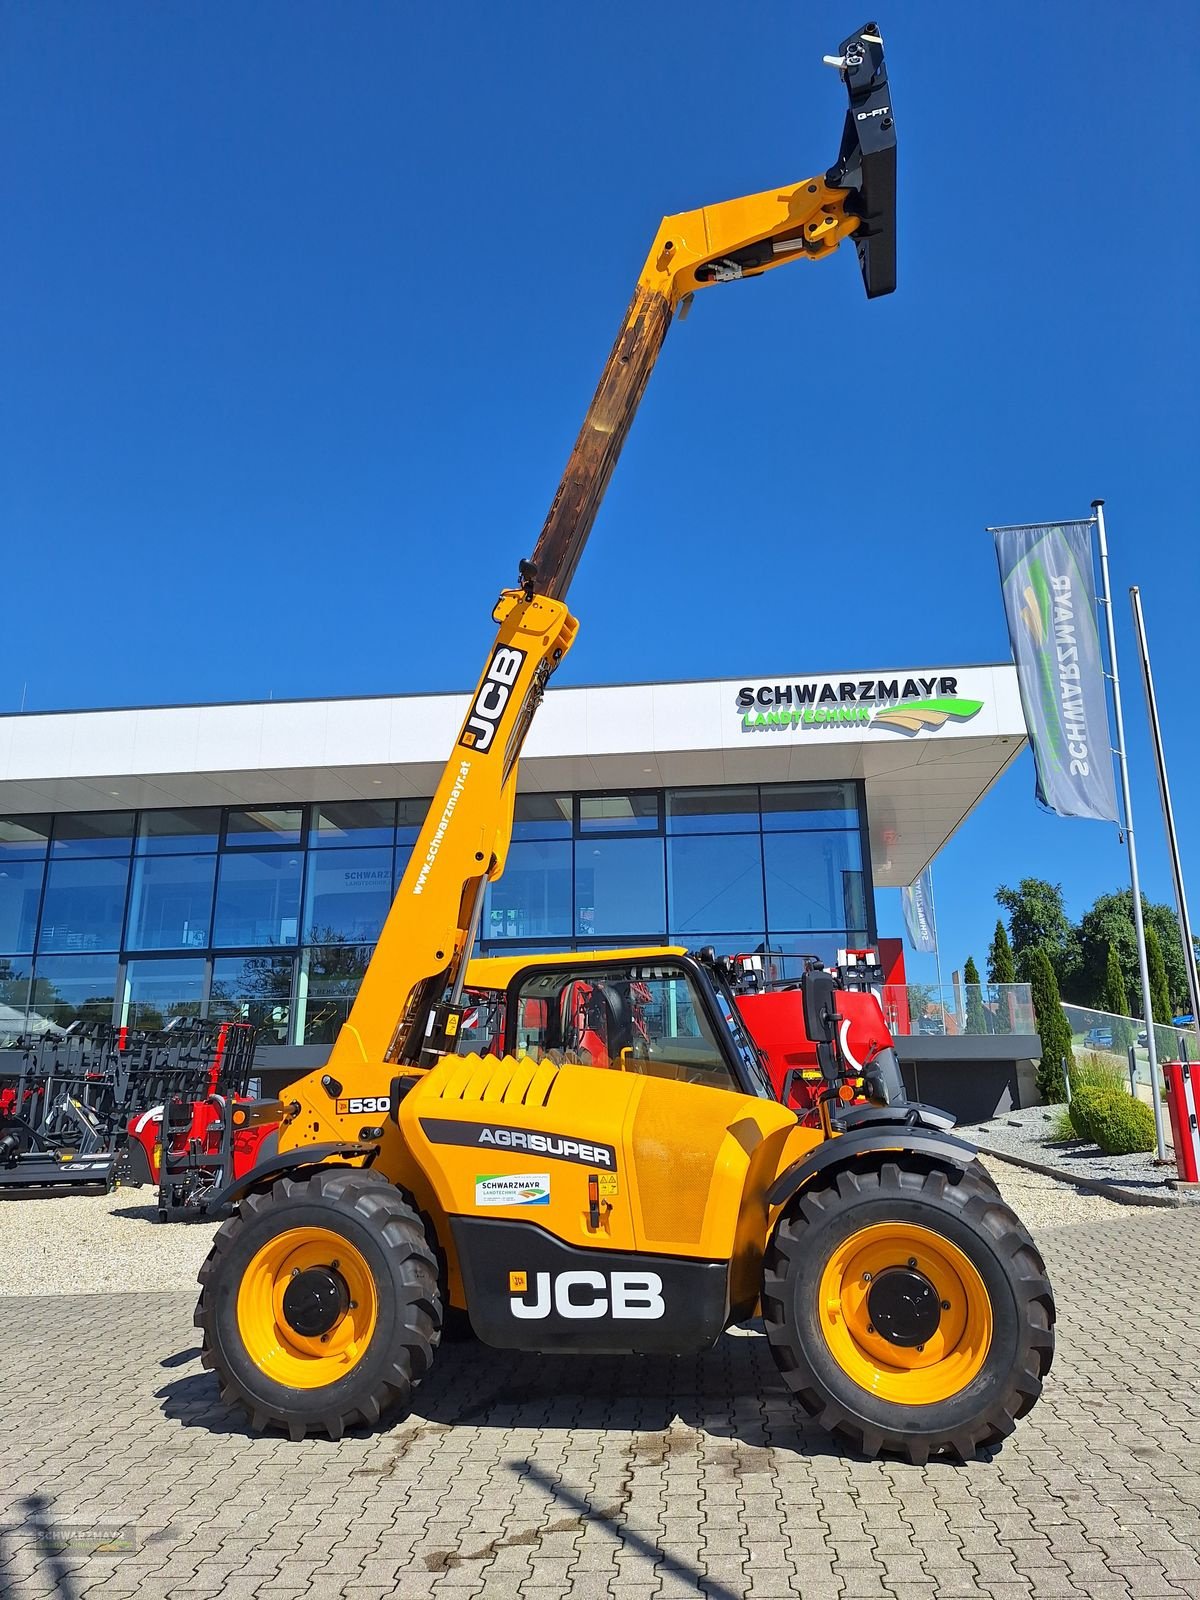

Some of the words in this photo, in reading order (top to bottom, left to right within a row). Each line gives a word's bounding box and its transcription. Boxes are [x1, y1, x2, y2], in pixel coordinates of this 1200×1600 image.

[469, 648, 523, 750] JCB
[738, 676, 958, 706] SCHWARZMAYR
[744, 707, 871, 726] LANDTECHNIK
[412, 760, 471, 895] www.schwarzmayr.at
[350, 1097, 390, 1113] 530
[478, 1128, 611, 1166] AGRISUPER
[482, 1181, 540, 1189] SCHWARZMAYR
[510, 1270, 665, 1320] JCB
